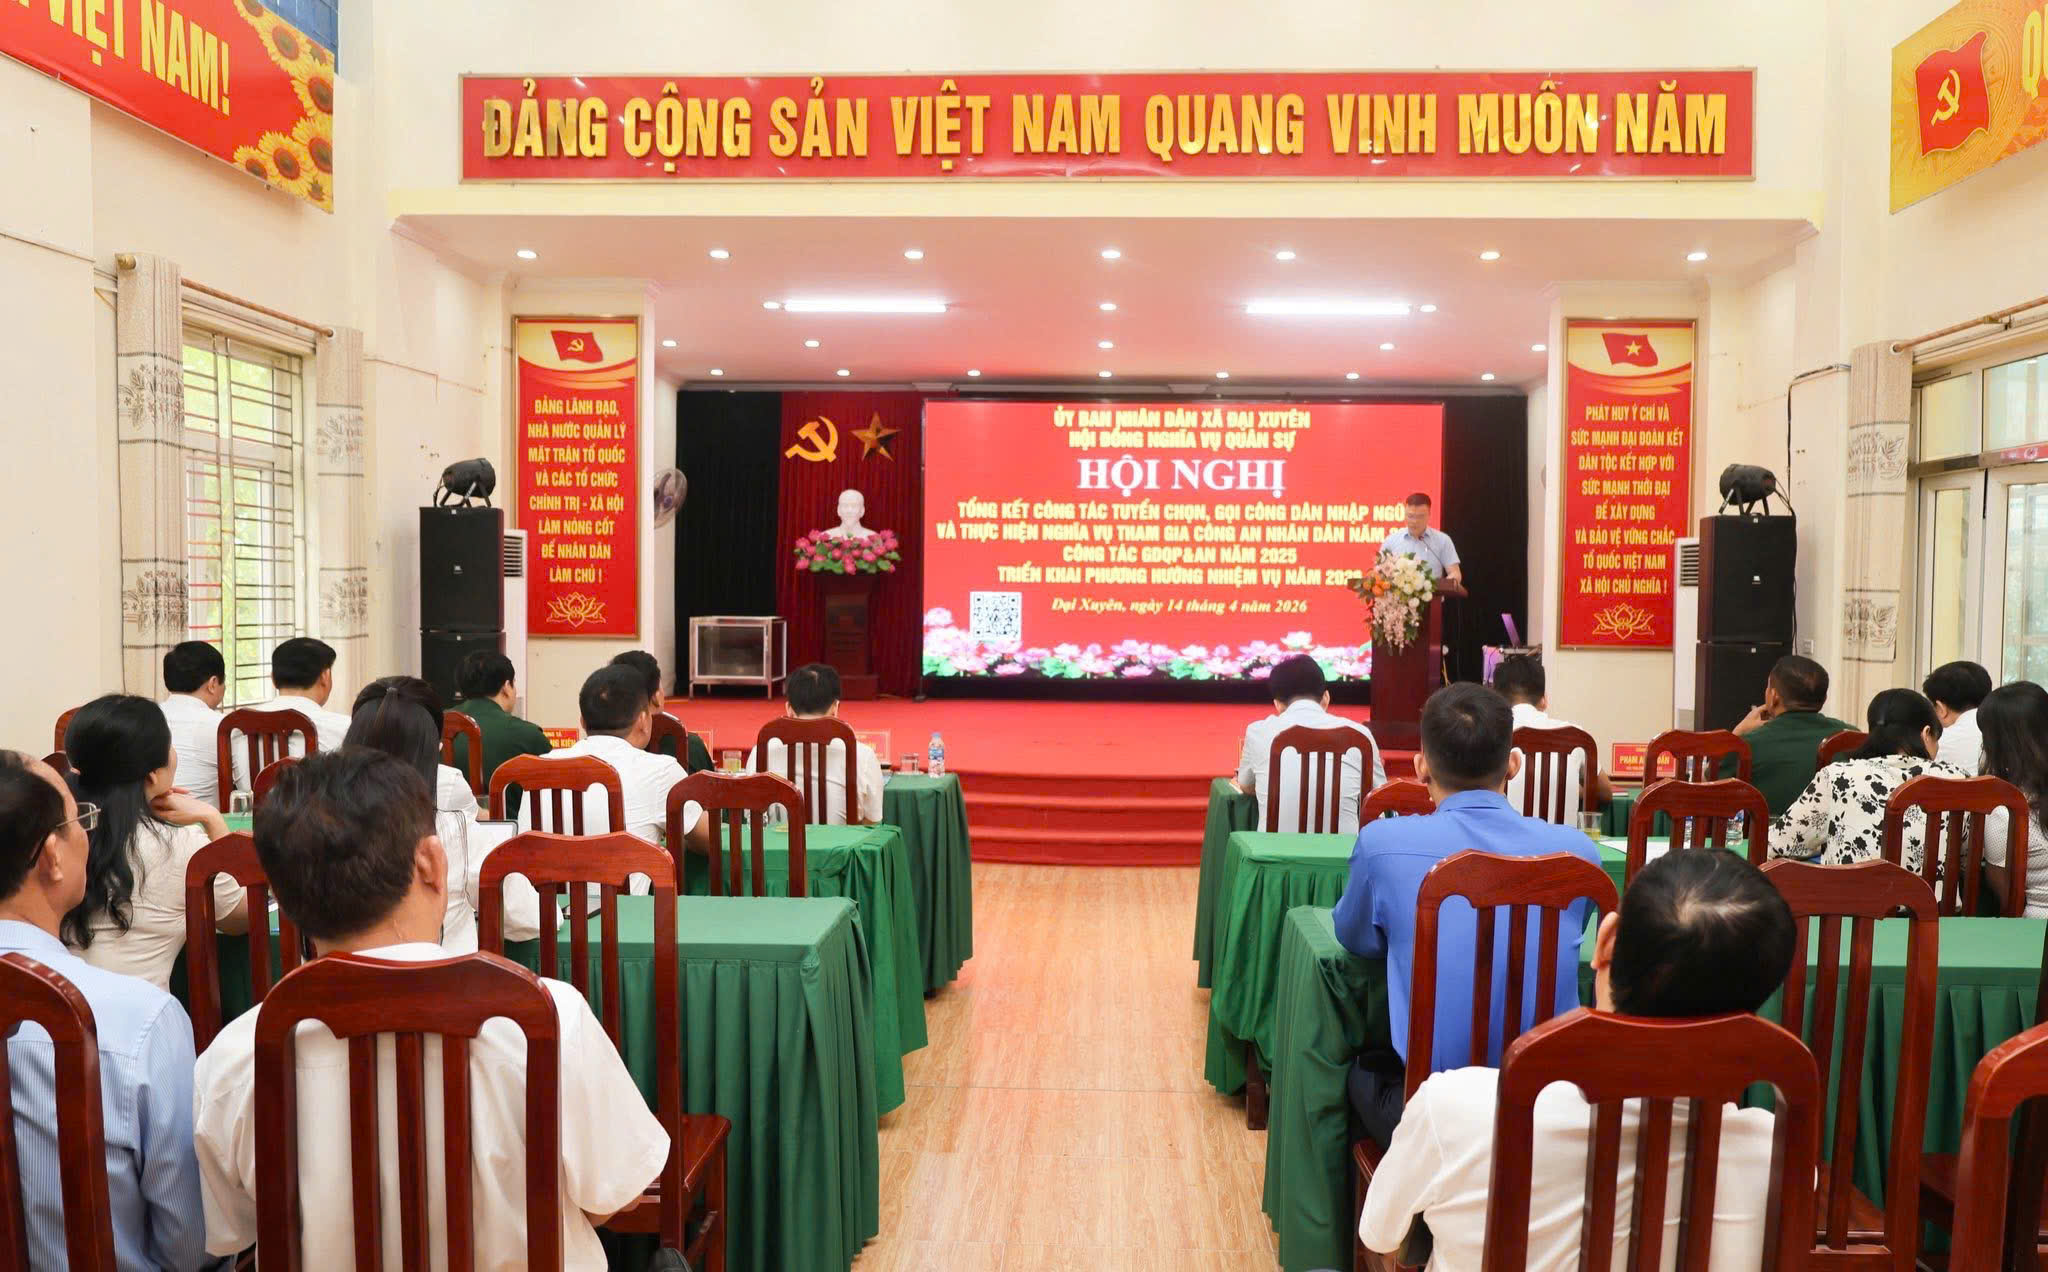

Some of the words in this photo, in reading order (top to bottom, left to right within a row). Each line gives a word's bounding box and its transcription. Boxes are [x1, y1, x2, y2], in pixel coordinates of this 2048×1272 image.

[141, 0, 230, 116] NAM!
[482, 78, 607, 158] ĐẢNG
[624, 82, 752, 172] CỘNG
[768, 76, 868, 158] SẢN
[891, 79, 991, 170] VIỆT
[1013, 93, 1121, 155] NAM
[1145, 93, 1304, 162] QUANG
[1327, 93, 1437, 154] VINH
[1459, 80, 1598, 154] MUÔN
[1616, 80, 1727, 154] NĂM
[535, 395, 563, 414] ĐẢNG
[566, 396, 592, 414] LÃNH
[596, 399, 619, 418] ĐẠO,
[1054, 404, 1075, 427] ỦY
[1078, 411, 1112, 427] BAN
[1115, 408, 1160, 428] NHÂN
[1164, 408, 1198, 428] DÂN
[1202, 409, 1223, 428] XÃ
[1226, 411, 1255, 431] ĐẠI
[1258, 408, 1311, 428] XUYÊN
[1586, 404, 1609, 420] PHÁT
[1612, 406, 1629, 420] HUY
[1632, 403, 1638, 420] Ý
[1640, 403, 1655, 420] CHÍ
[1658, 403, 1670, 420] VÀ
[528, 421, 549, 438] NHÀ
[552, 421, 580, 438] NƯỚC
[583, 419, 611, 440] QUẢN
[614, 422, 626, 438] LÝ
[1069, 428, 1096, 450] HỘI
[1100, 425, 1143, 448] ĐỒNG
[1147, 429, 1197, 449] NGHĨA
[1200, 431, 1222, 451] VỤ
[1225, 429, 1269, 449] QUÂN
[1273, 430, 1296, 452] SỰ
[1571, 428, 1589, 445] SỨC
[1592, 431, 1619, 448] MẠNH
[1622, 431, 1636, 449] ĐẠI
[1640, 428, 1664, 446] ĐOÀN
[1667, 427, 1683, 445] KẾT
[528, 445, 550, 465] MẶT
[553, 445, 580, 466] TRẬN
[583, 443, 596, 463] TỔ
[598, 443, 625, 464] QUỐC
[1579, 452, 1598, 470] DÂN
[1601, 453, 1617, 473] TỘC
[1620, 451, 1637, 470] KẾT
[1639, 454, 1657, 473] HỢP
[1660, 453, 1674, 470] VỚI
[536, 468, 549, 486] VÀ
[552, 468, 572, 486] CÁC
[575, 466, 588, 486] TỔ
[591, 469, 618, 486] CHỨC
[1076, 454, 1161, 497] HỘI
[1170, 458, 1287, 498] NGHỊ
[1582, 477, 1600, 495] SỨC
[1603, 480, 1630, 498] MẠNH
[1632, 478, 1652, 495] THỜI
[1655, 480, 1670, 498] ĐẠI
[529, 494, 561, 510] CHÍNH
[564, 496, 580, 513] TRỊ
[590, 494, 604, 511] XÃ
[607, 494, 624, 514] HỘI
[958, 496, 998, 520] TỔNG
[1001, 498, 1030, 520] KẾT
[1033, 500, 1075, 520] CÔNG
[1079, 501, 1108, 520] TÁC
[1112, 498, 1160, 521] TUYỂN
[1164, 503, 1211, 524] CHỌN,
[1215, 504, 1241, 524] GỌI
[1244, 501, 1287, 521] CÔNG
[1290, 501, 1323, 521] DÂN
[1327, 503, 1369, 524] NHẬP
[1596, 500, 1608, 520] ĐỂ
[1610, 502, 1628, 520] XÂY
[1630, 505, 1655, 523] DỰNG
[538, 516, 560, 534] LÀM
[564, 517, 592, 534] NÒNG
[595, 516, 614, 535] CỐT
[936, 520, 956, 539] VÀ
[959, 522, 999, 543] THỰC
[1002, 522, 1039, 543] HIỆN
[1042, 522, 1089, 541] NGHĨA
[1093, 525, 1113, 544] VỤ
[1116, 525, 1160, 541] THAM
[1164, 525, 1190, 541] GIA
[1193, 522, 1236, 542] CÔNG
[1239, 526, 1261, 542] AN
[1265, 523, 1309, 542] NHÂN
[1312, 523, 1345, 543] DÂN
[1349, 524, 1385, 543] NĂM
[1576, 526, 1587, 544] VÀ
[1590, 525, 1608, 544] BẢO
[1611, 528, 1622, 548] VỆ
[1624, 527, 1648, 544] VỮNG
[1651, 525, 1674, 544] CHẮC
[542, 539, 555, 558] ĐỂ
[558, 541, 586, 559] NHÂN
[590, 541, 611, 559] DÂN
[1063, 543, 1105, 562] CÔNG
[1108, 543, 1137, 563] TÁC
[1141, 546, 1216, 564] GDQP&AN
[1220, 544, 1256, 563] NĂM
[1260, 548, 1297, 564] 2025
[1583, 549, 1594, 569] TỔ
[1597, 549, 1620, 570] QUỐC
[1623, 552, 1642, 572] VIỆT
[1645, 555, 1666, 569] NAM
[550, 565, 571, 582] LÀM
[575, 564, 596, 582] CHỦ
[998, 561, 1042, 583] TRIỂN
[1045, 567, 1081, 583] KHAI
[1085, 567, 1147, 584] PHƯƠNG
[1151, 566, 1203, 585] HƯỚNG
[1207, 567, 1258, 588] NHIỆM
[1261, 569, 1282, 588] VỤ
[1285, 567, 1321, 585] NĂM
[1580, 576, 1592, 593] XÃ
[1595, 576, 1610, 597] HỘI
[1612, 575, 1630, 593] CHỦ
[1633, 576, 1661, 593] NGHĨA
[1130, 600, 1163, 614] ngày
[1167, 600, 1183, 612] 14
[1186, 600, 1225, 615] tháng
[1229, 600, 1238, 612] 4
[1241, 602, 1271, 613] năm
[1276, 600, 1308, 612] 2026
